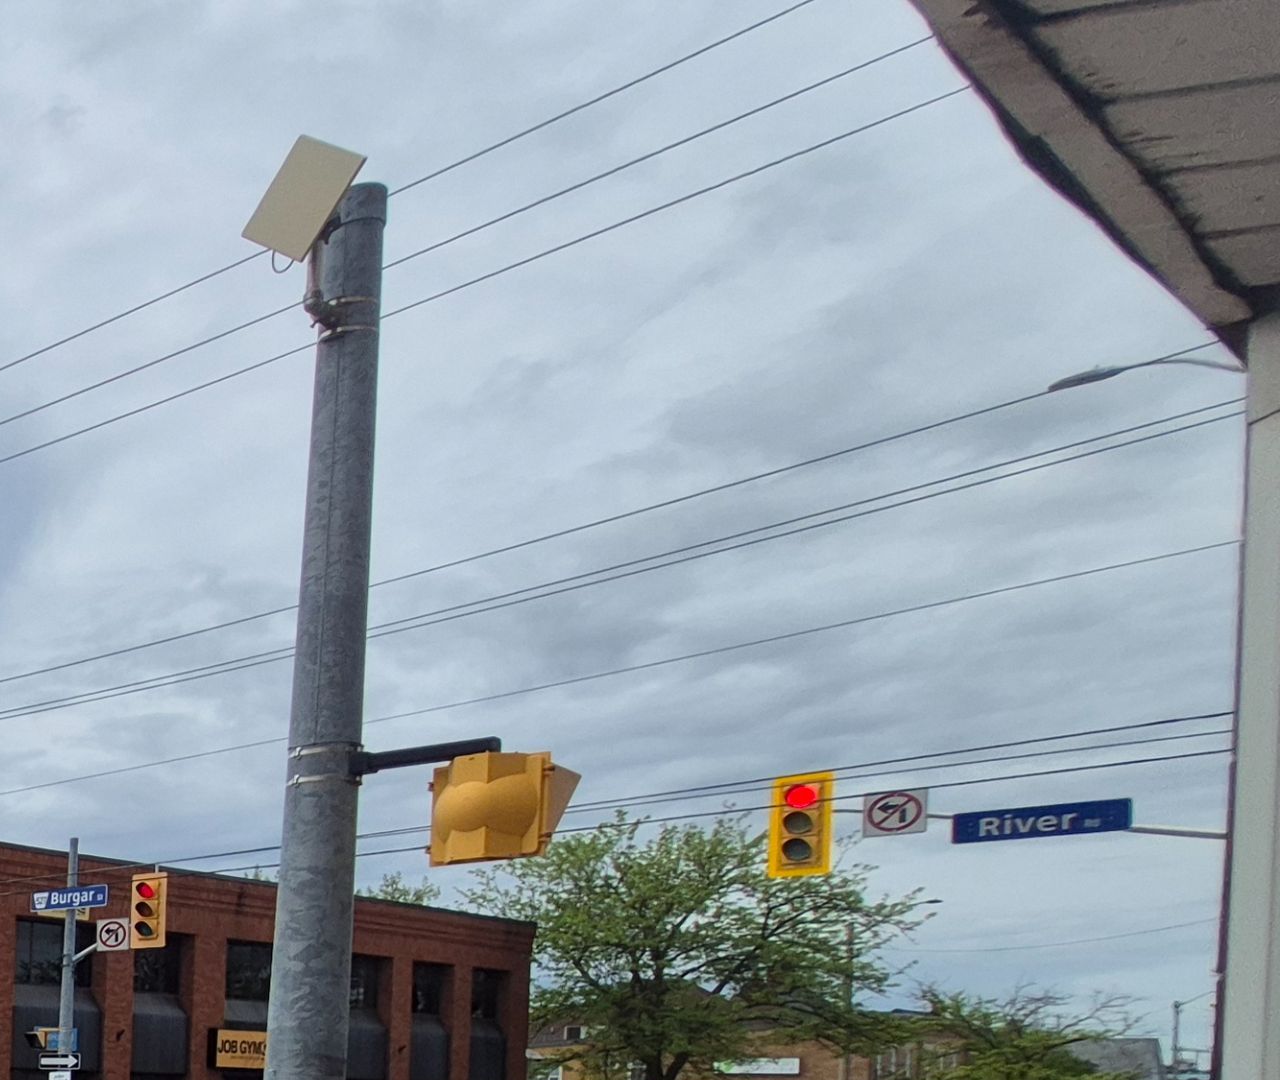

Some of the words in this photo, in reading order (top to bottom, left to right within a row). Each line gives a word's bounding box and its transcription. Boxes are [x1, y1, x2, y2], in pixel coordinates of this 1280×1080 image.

[978, 812, 1078, 837] River
[51, 890, 95, 906] Burgar
[218, 1039, 238, 1054] JOB
